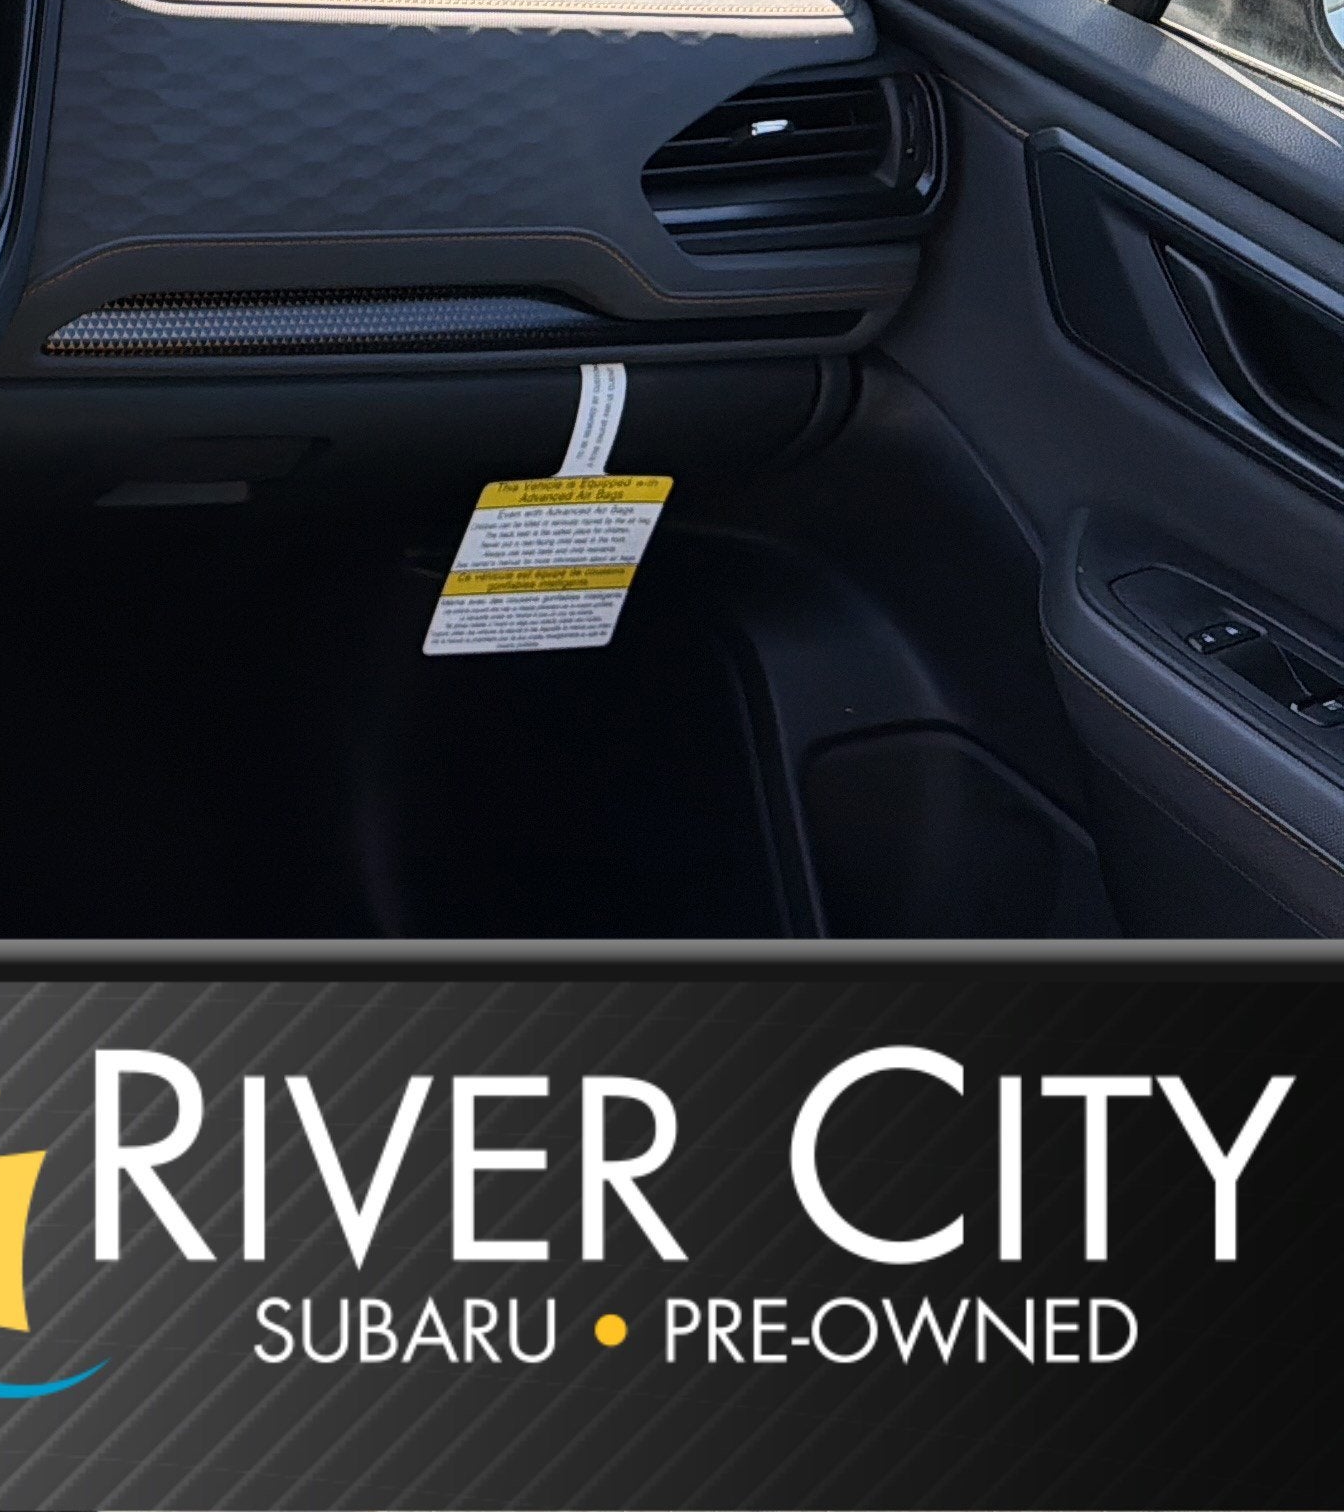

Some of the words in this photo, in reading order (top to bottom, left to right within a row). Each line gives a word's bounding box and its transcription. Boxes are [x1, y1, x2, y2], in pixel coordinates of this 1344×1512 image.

[579, 478, 632, 491] Equipped
[519, 490, 573, 504] Advanced
[576, 490, 592, 501] Air
[596, 489, 624, 502] Bags
